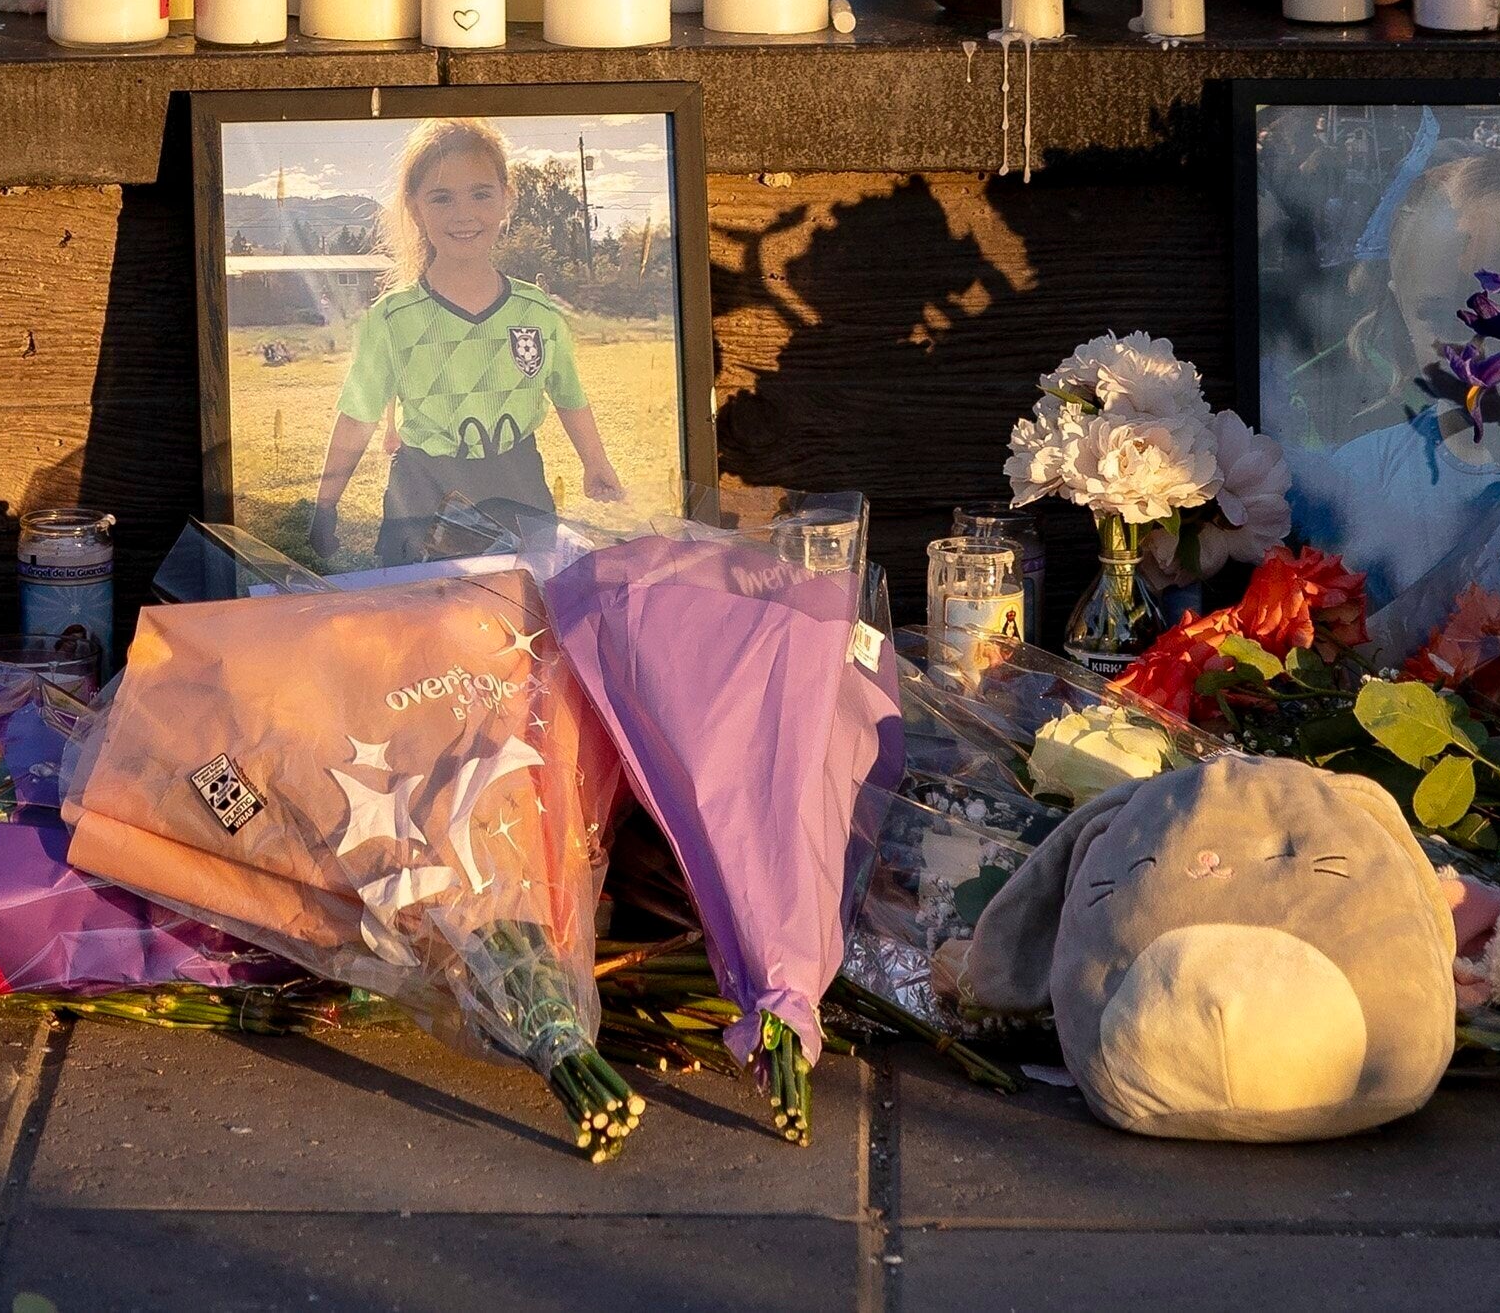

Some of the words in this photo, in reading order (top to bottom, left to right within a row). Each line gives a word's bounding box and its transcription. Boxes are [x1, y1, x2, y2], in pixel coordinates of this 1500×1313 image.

[53, 568, 64, 577] de
[67, 568, 75, 577] la
[77, 565, 107, 577] Guarda
[224, 796, 253, 824] PLASTIC
[233, 807, 255, 829] WRAP
